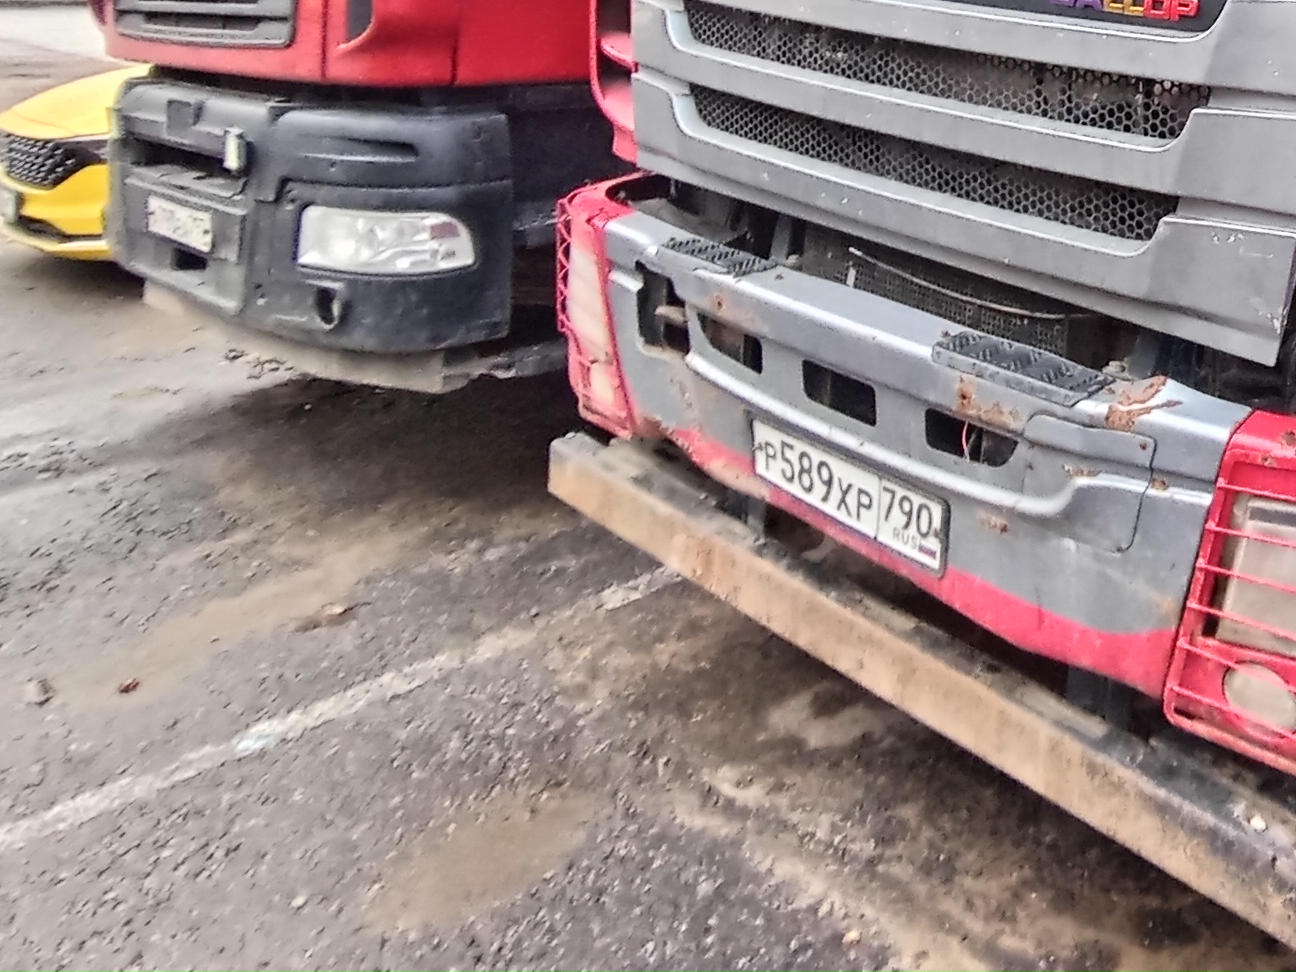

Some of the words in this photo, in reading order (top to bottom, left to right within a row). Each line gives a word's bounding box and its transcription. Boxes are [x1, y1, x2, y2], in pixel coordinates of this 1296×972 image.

[764, 440, 873, 523] Р589ХР
[882, 486, 933, 539] 790
[892, 527, 918, 550] RUS
